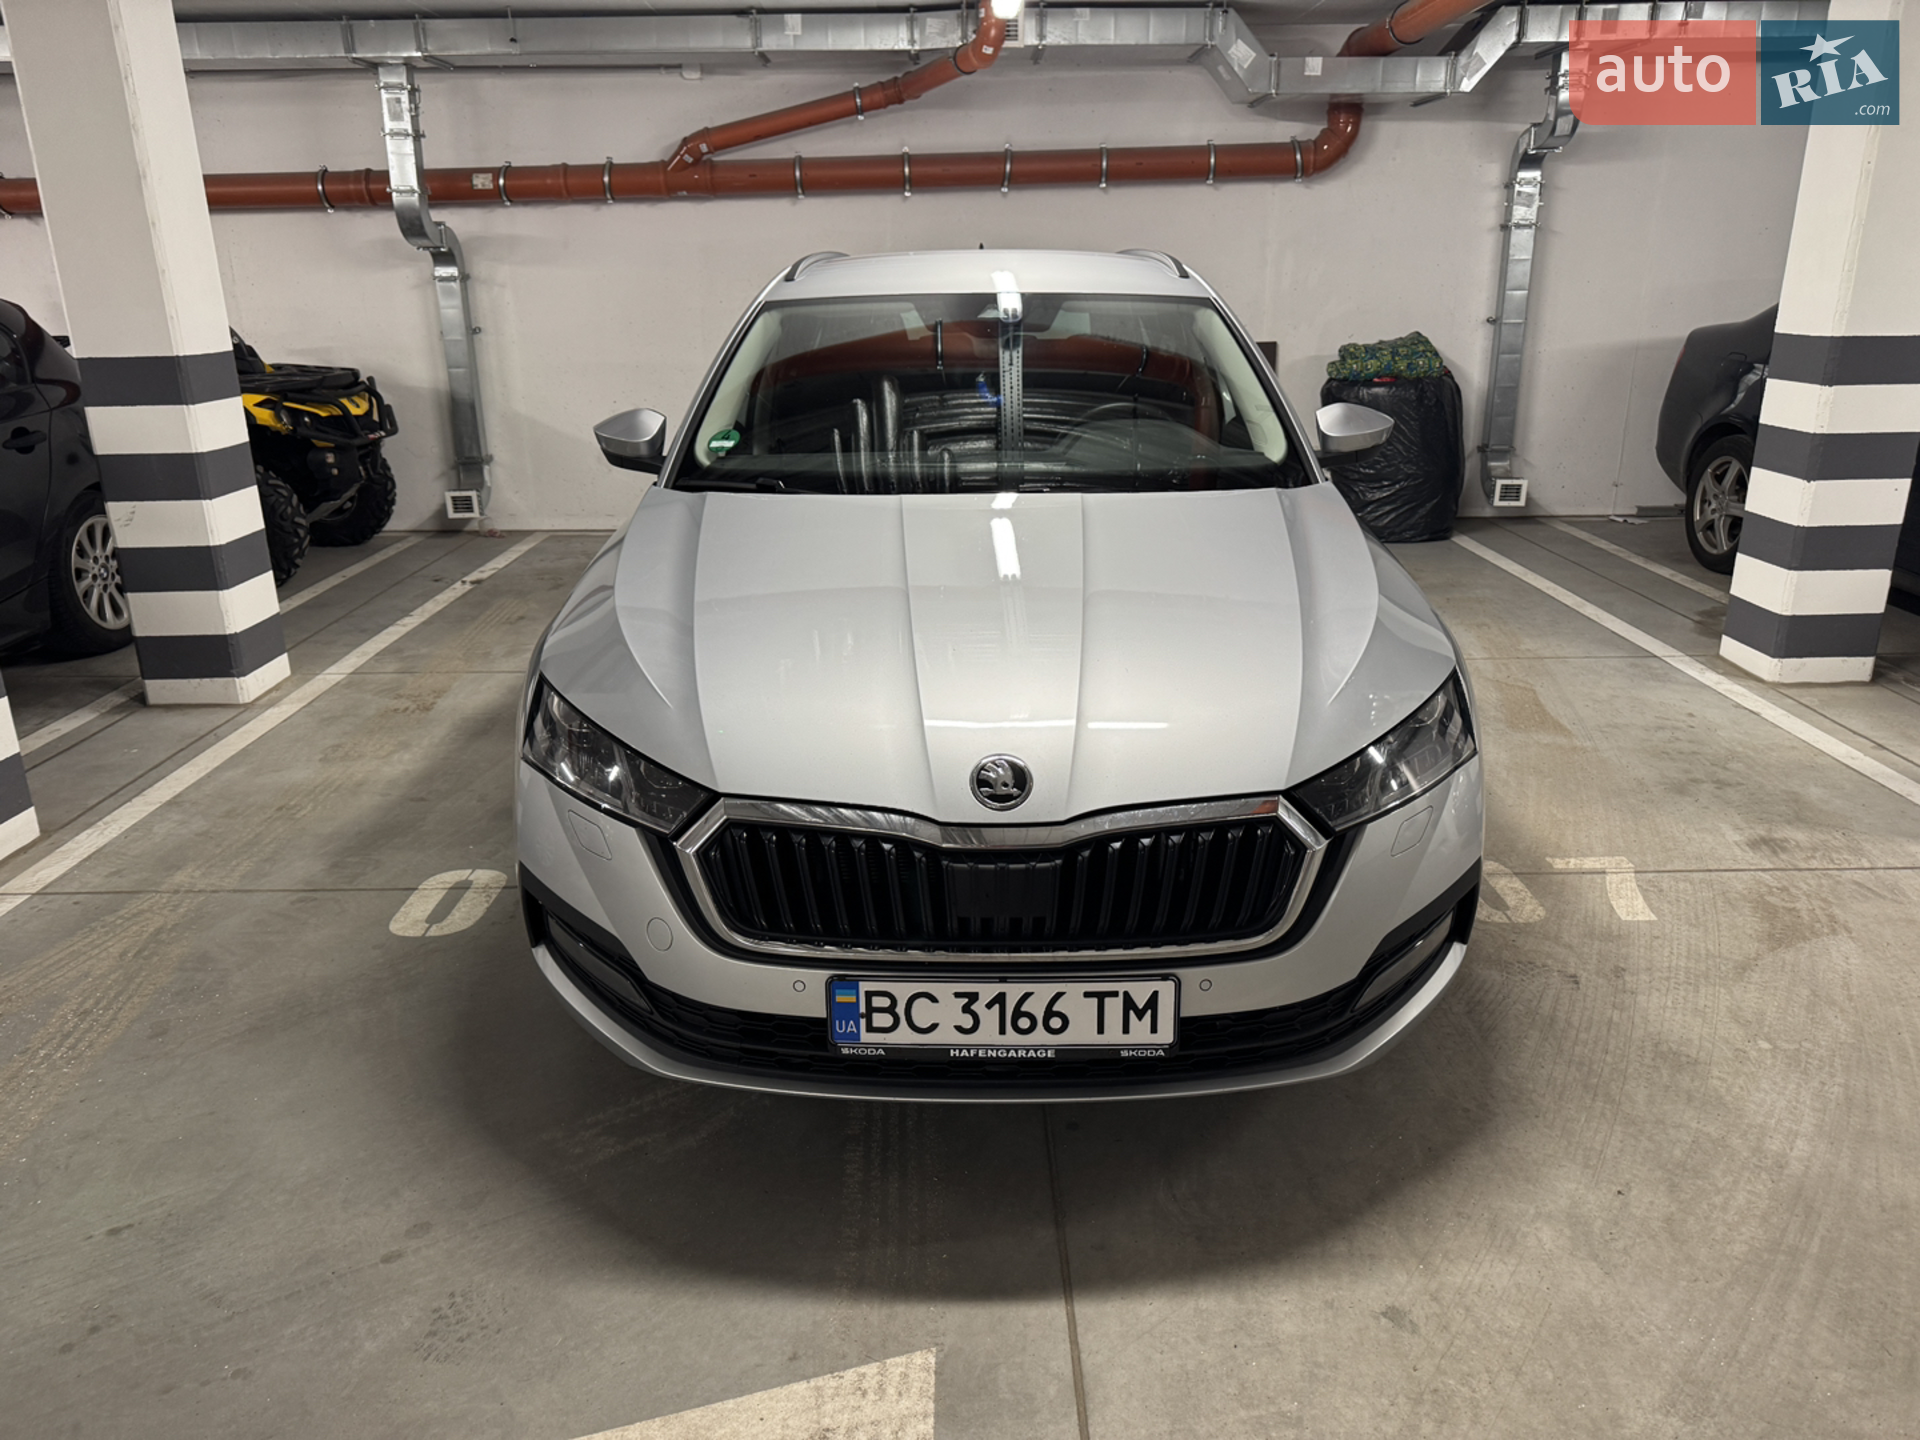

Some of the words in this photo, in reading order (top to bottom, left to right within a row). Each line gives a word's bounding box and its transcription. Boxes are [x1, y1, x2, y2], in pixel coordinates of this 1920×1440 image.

[864, 990, 940, 1035] BC
[953, 991, 1070, 1036] 3166
[1083, 990, 1159, 1035] TM
[835, 1020, 858, 1034] UA
[950, 1048, 1056, 1059] HAFENGARAGE
